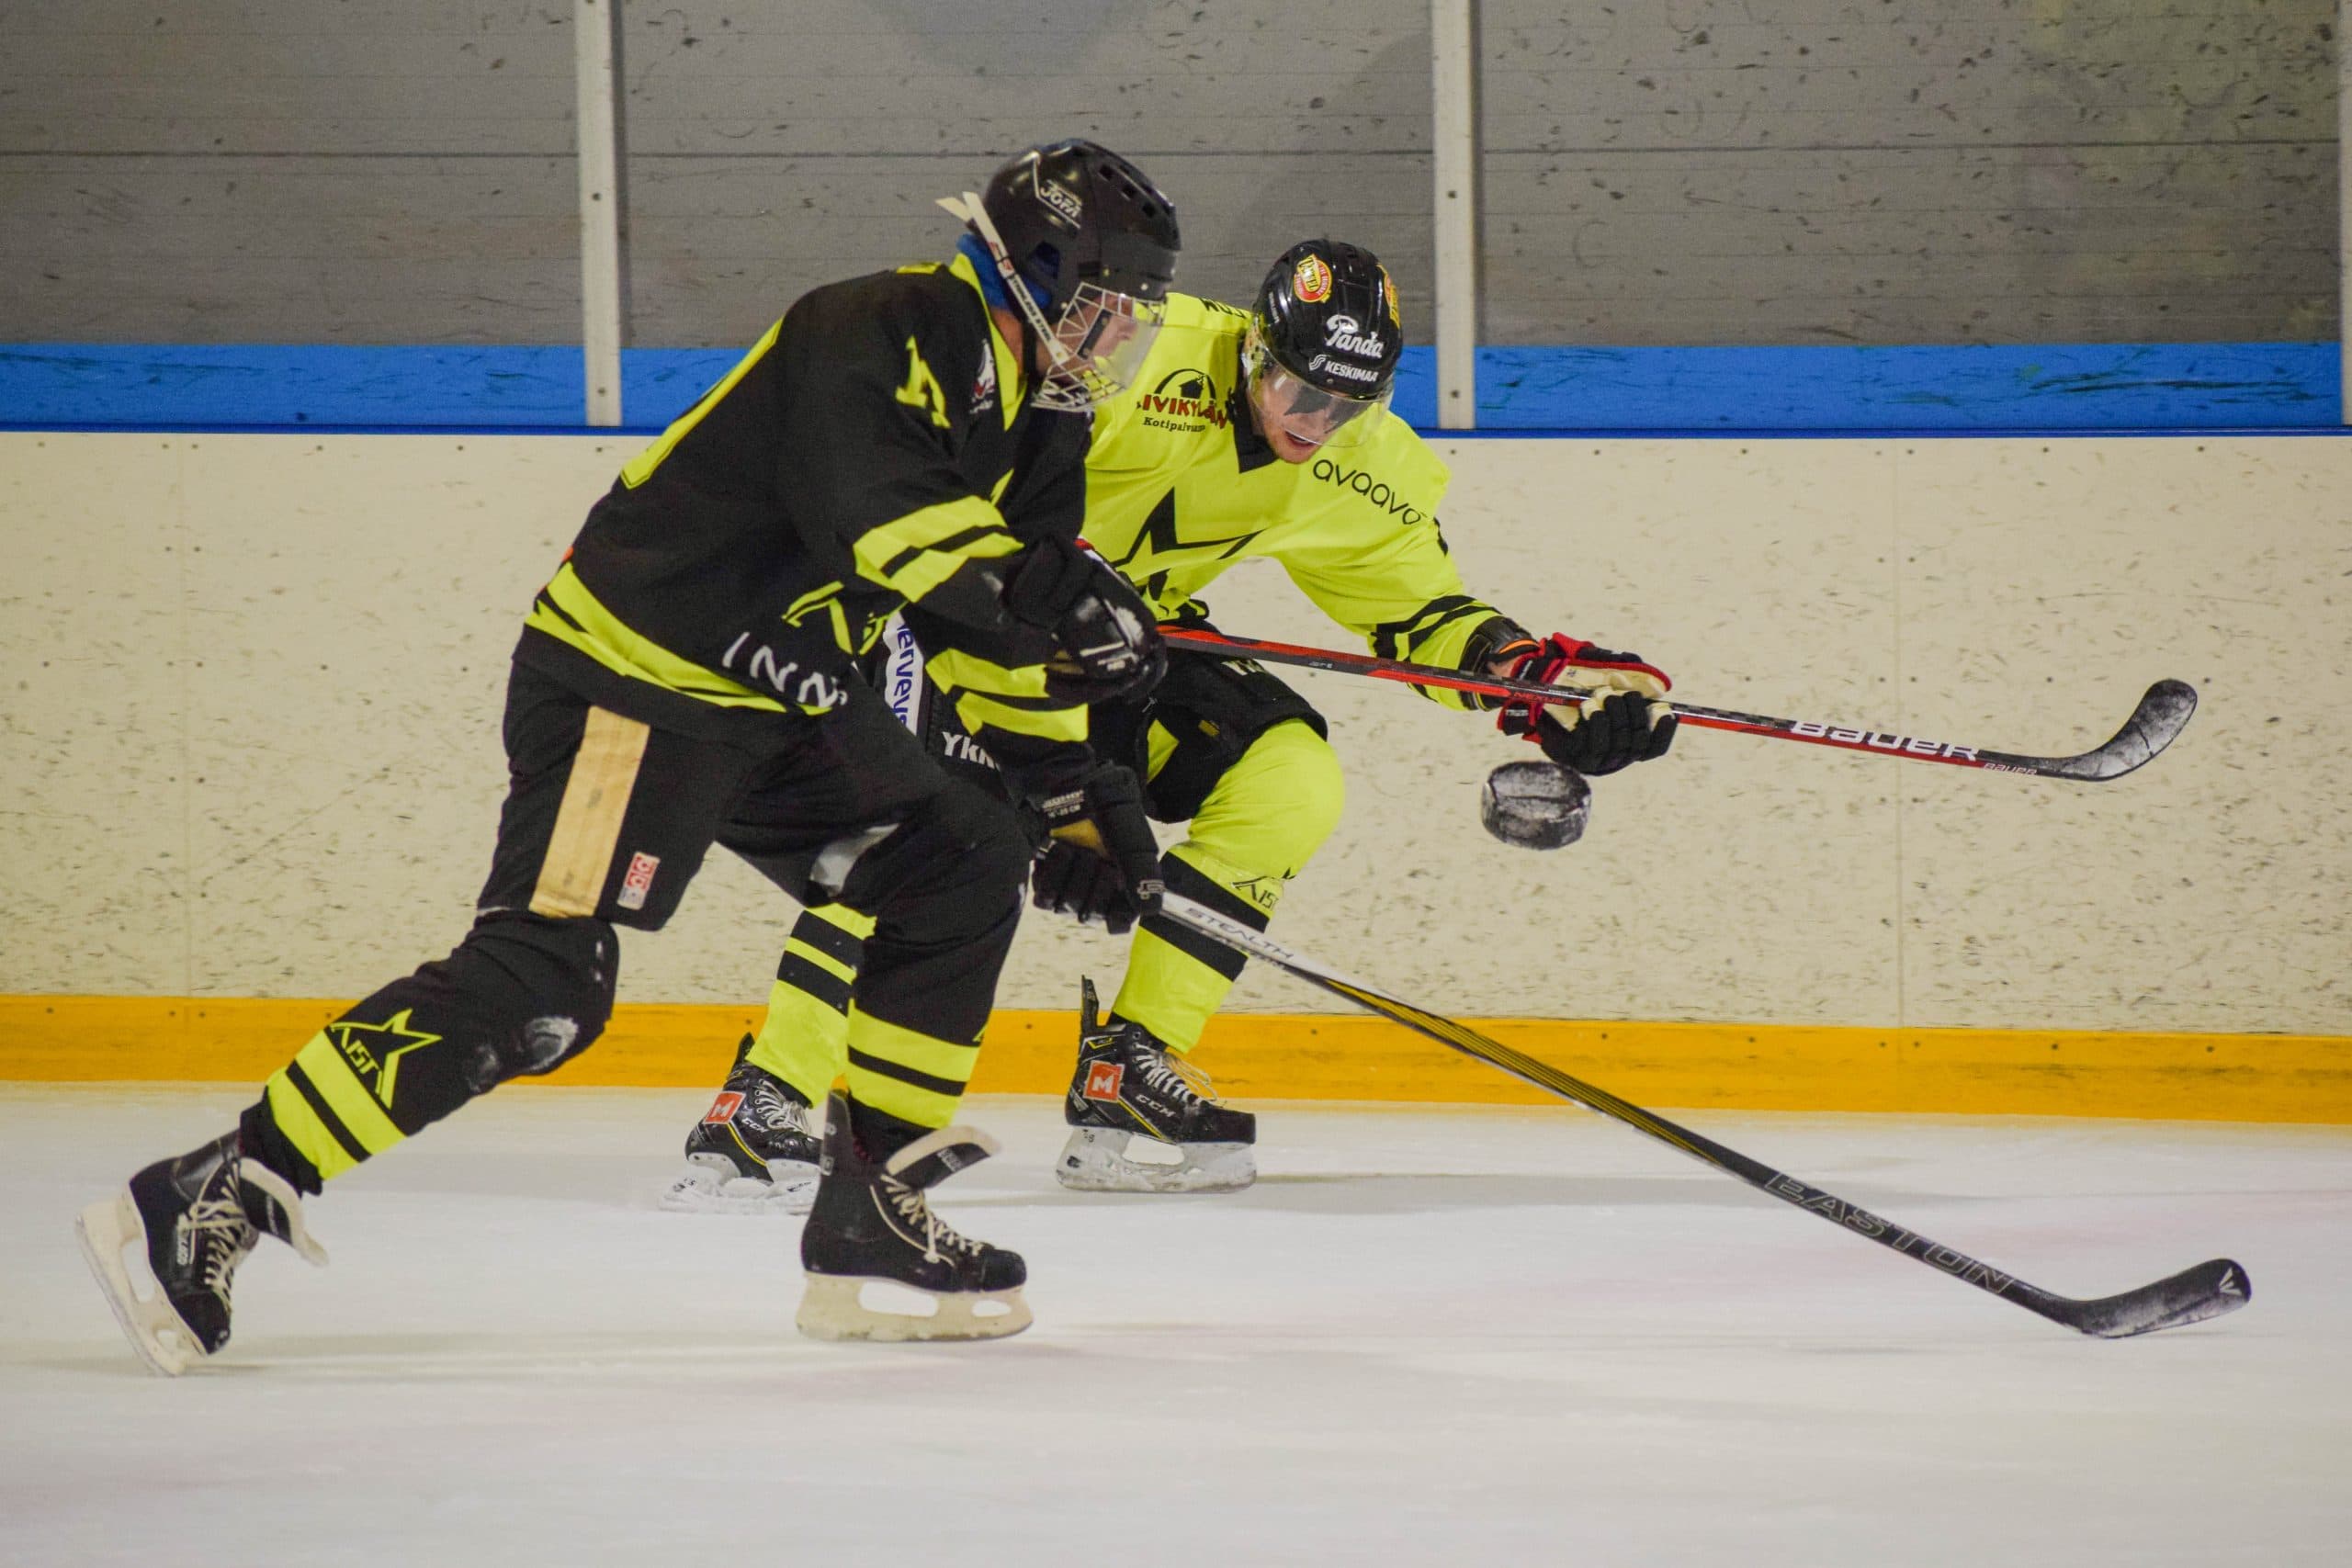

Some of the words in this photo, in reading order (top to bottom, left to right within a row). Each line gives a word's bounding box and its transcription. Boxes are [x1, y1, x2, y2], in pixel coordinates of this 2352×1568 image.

[1326, 314, 1385, 359] Panda
[1324, 360, 1379, 382] KESKIMAA
[1136, 394, 1227, 430] IVIKYLÄN
[1789, 720, 1978, 761] BAUER
[1982, 761, 2038, 776] BAUER
[1184, 907, 1295, 959] STEALTH
[1135, 1093, 1177, 1118] CCM
[1765, 1171, 2016, 1294] EASTON
